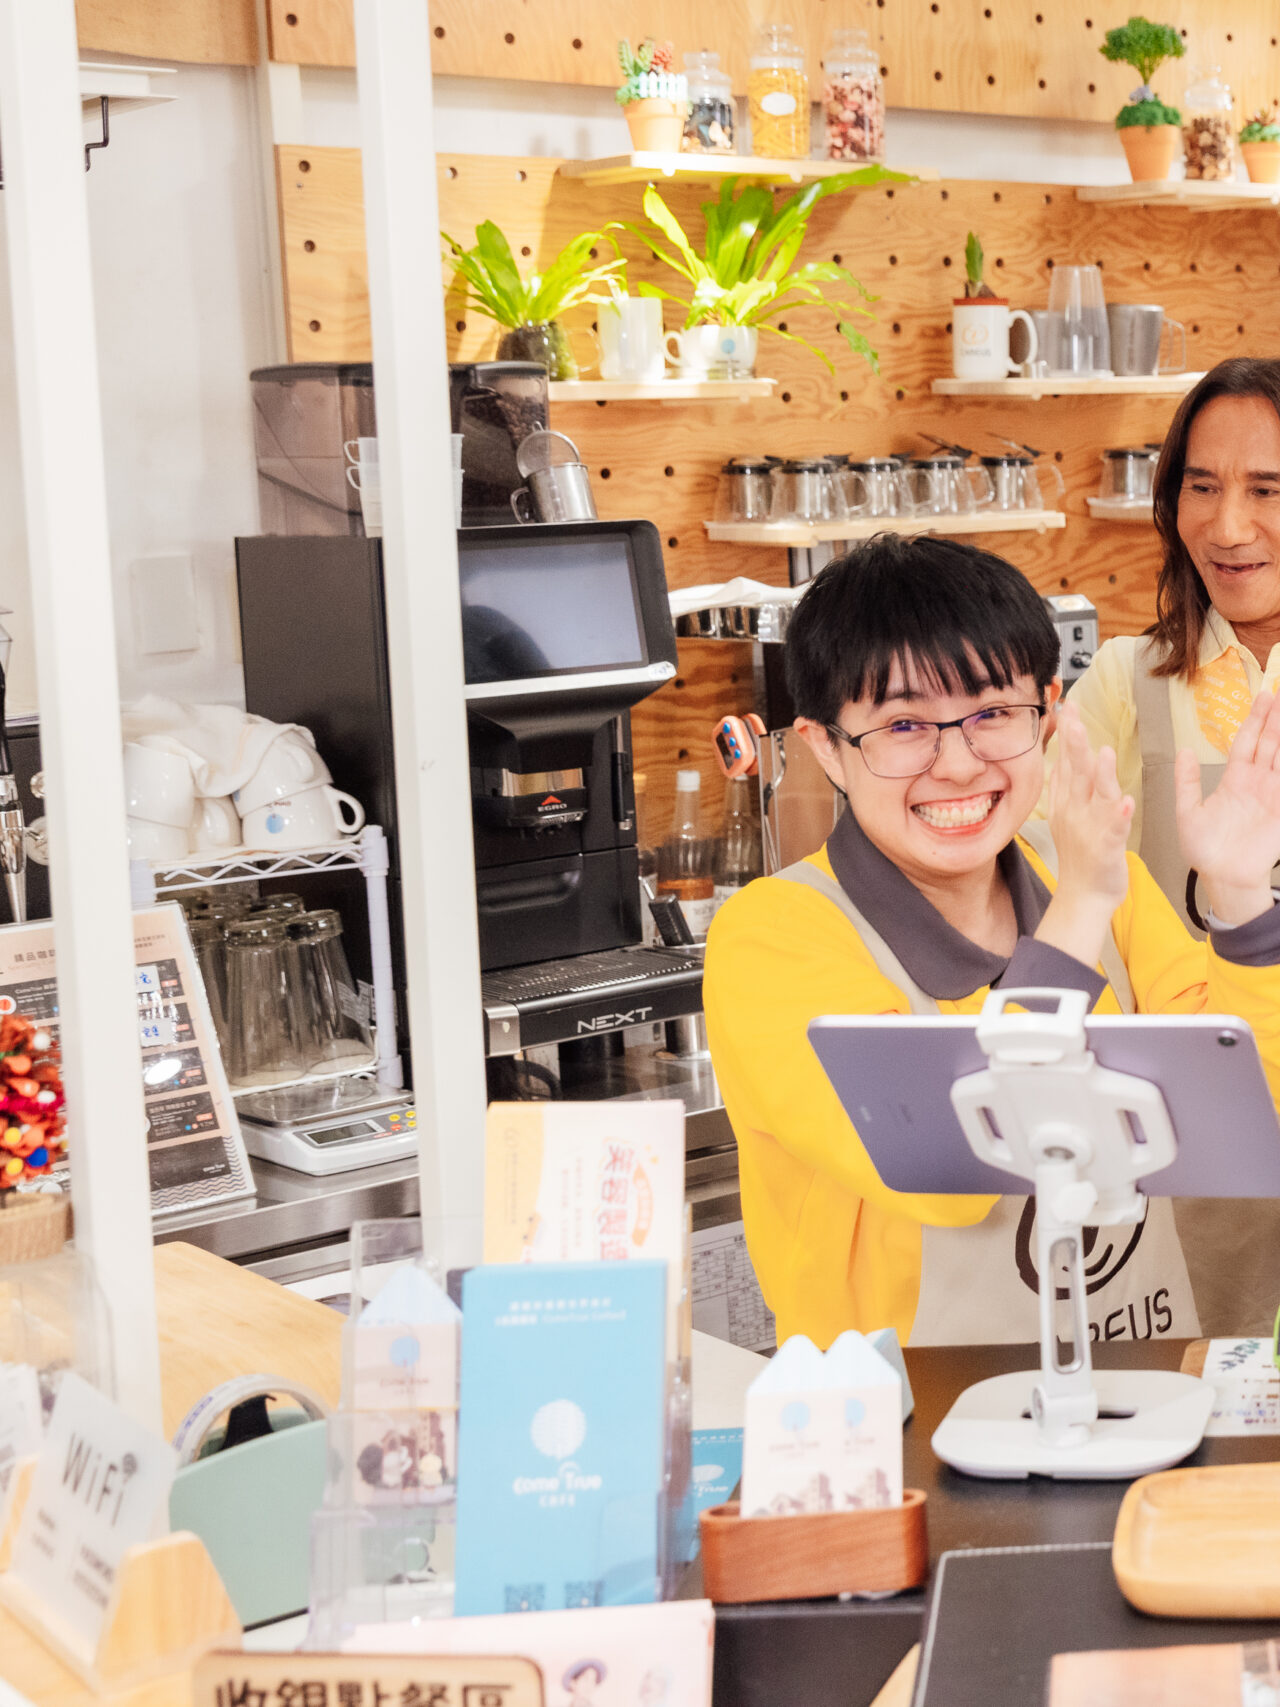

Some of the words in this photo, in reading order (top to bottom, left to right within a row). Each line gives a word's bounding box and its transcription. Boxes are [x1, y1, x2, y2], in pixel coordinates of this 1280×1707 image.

[537, 803, 568, 812] EGRO
[577, 1006, 653, 1034] NEXT
[61, 1431, 126, 1528] WiFi
